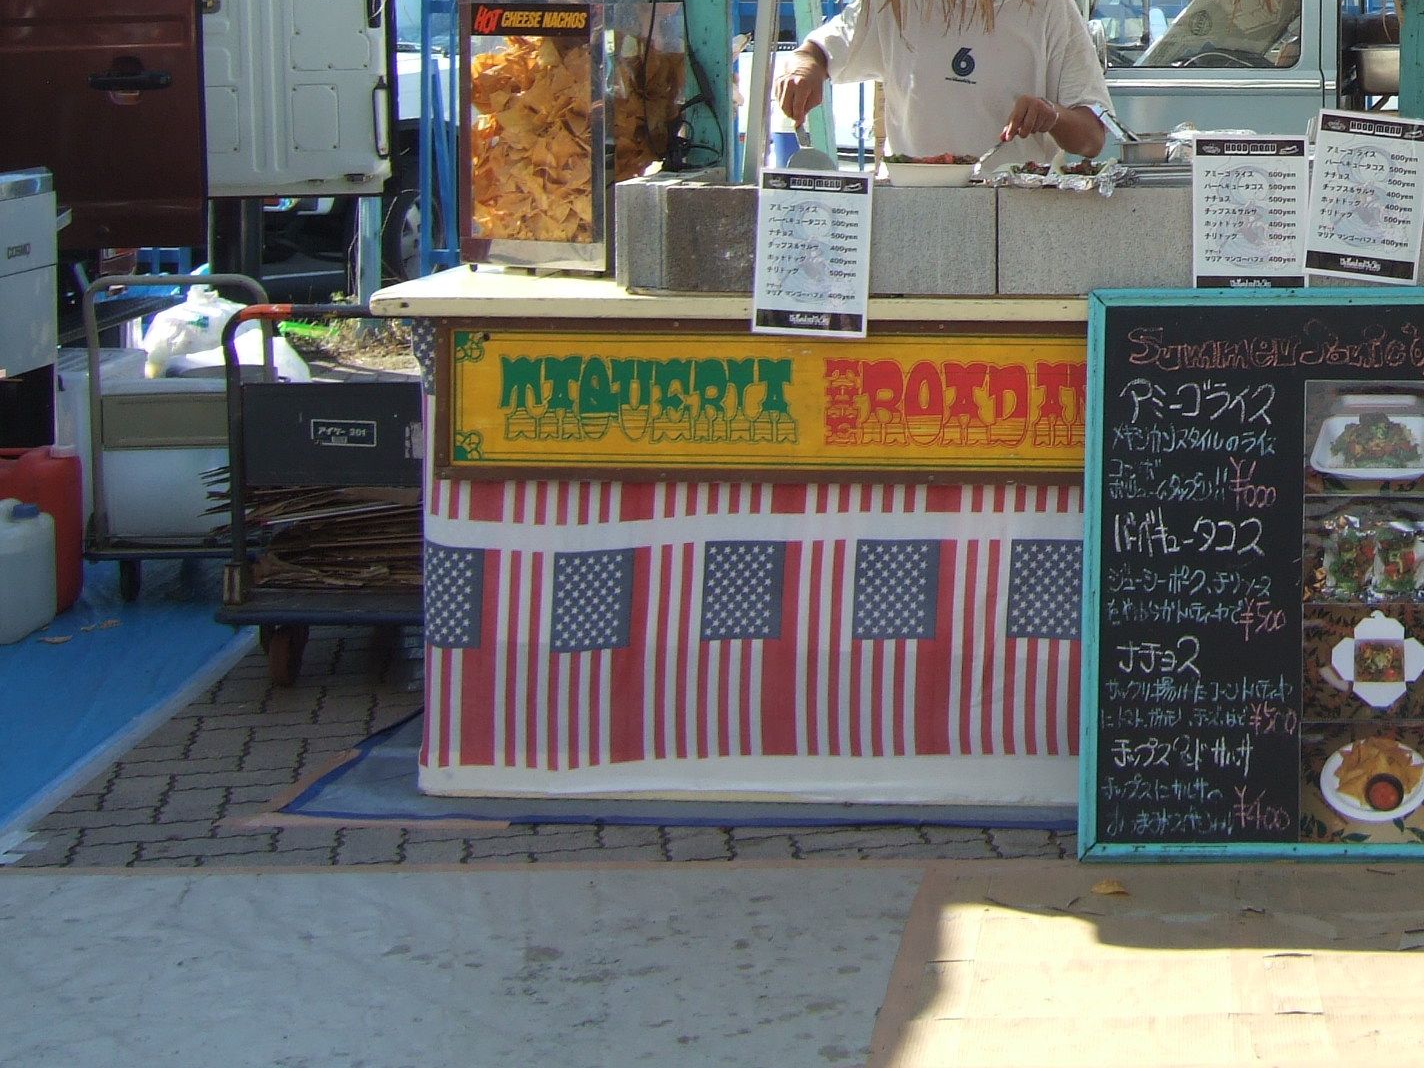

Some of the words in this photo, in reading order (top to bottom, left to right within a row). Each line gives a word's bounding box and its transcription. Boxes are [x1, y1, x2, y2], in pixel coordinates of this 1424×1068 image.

[474, 5, 502, 34] HOT
[501, 11, 541, 28] CHEESE
[542, 12, 587, 29] NACHOS
[952, 48, 976, 77] 6
[1391, 154, 1418, 163] 600yen
[1268, 171, 1296, 179] 600yen
[1389, 167, 1417, 175] 500yen
[1388, 179, 1415, 188] 500yen
[1268, 196, 1296, 204] 500yen
[1386, 192, 1414, 200] 400yen
[1385, 204, 1412, 213] 400yen
[1268, 221, 1296, 229] 400yen
[1384, 216, 1411, 225] 500yen
[1381, 239, 1408, 248] 400yen
[1268, 256, 1296, 264] 400yen
[500, 355, 800, 444] TAQUERIA
[824, 357, 862, 445] THE
[858, 358, 1030, 447] ROAD
[1119, 378, 1276, 425] アミーゴライス
[1116, 635, 1201, 677] ナチョス
